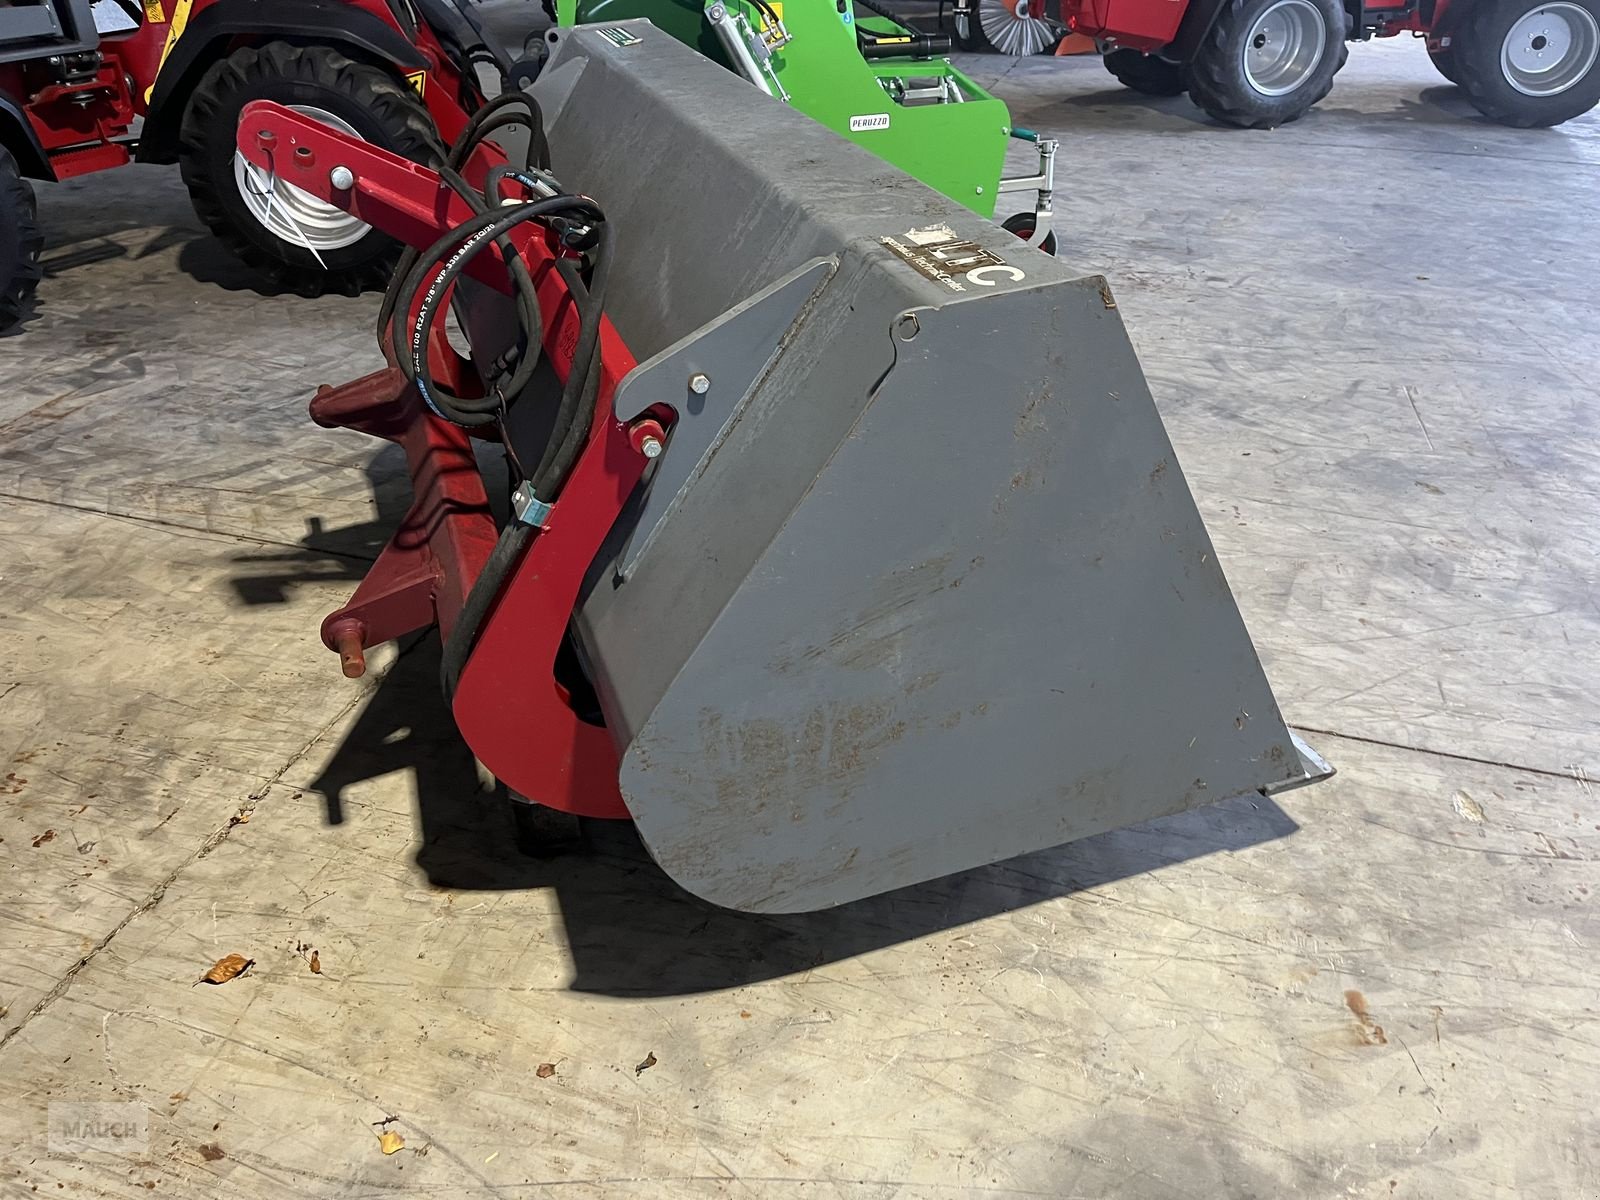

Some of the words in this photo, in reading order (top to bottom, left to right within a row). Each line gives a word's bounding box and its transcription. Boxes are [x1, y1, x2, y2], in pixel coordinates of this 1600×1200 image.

[852, 117, 888, 128] PERUZZO
[458, 239, 476, 255] BAR
[445, 255, 460, 269] 330
[435, 269, 447, 284] WP
[425, 284, 436, 303] 3/8"
[415, 304, 428, 331] R2AT
[413, 332, 421, 349] 100
